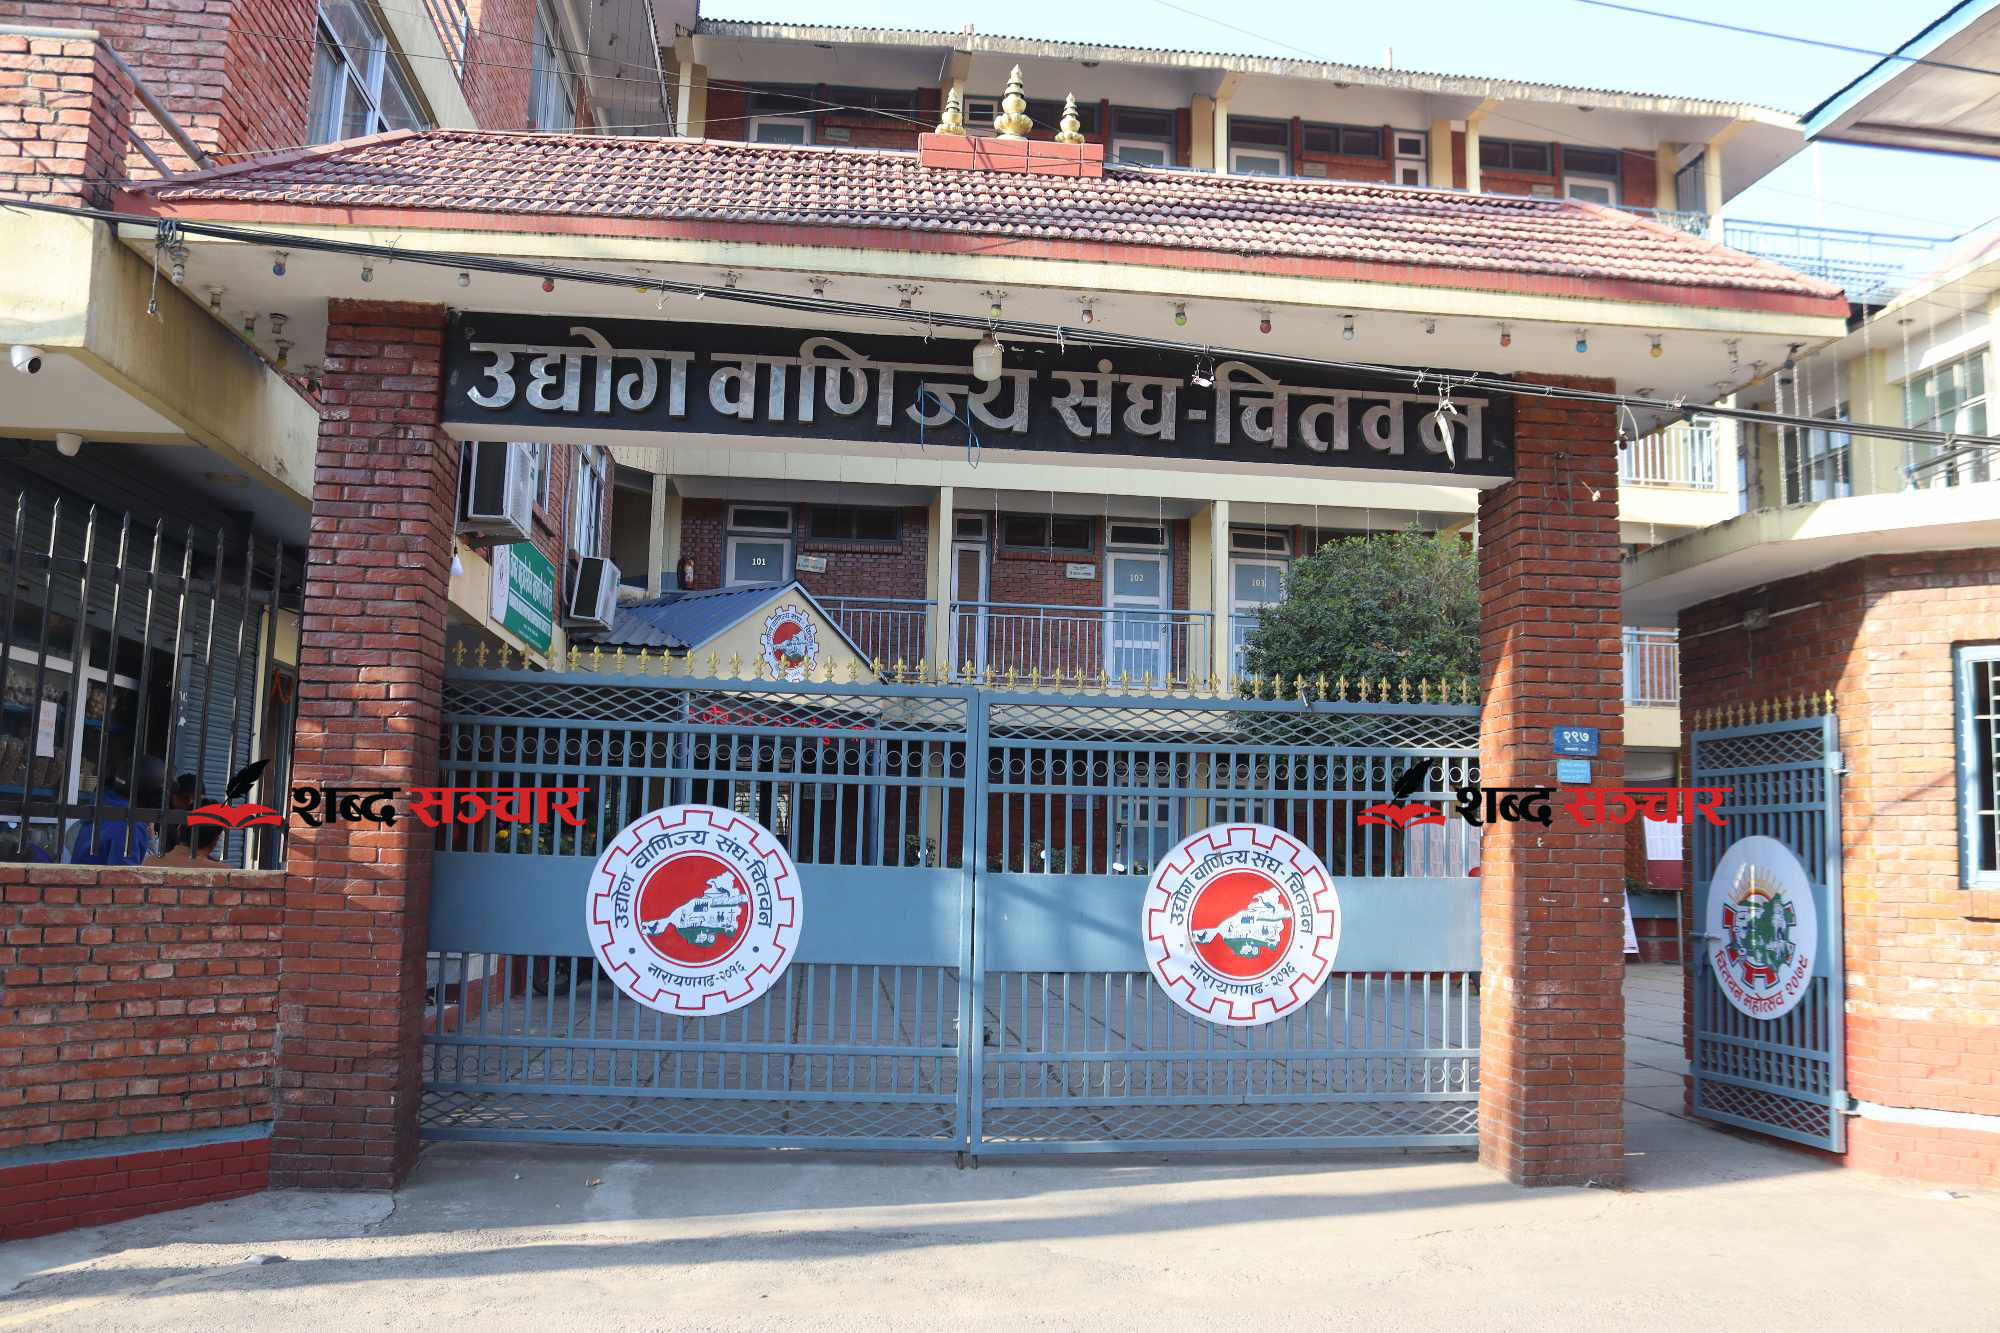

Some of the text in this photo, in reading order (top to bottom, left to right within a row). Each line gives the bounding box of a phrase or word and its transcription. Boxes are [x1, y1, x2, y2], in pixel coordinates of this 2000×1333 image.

[466, 326, 695, 417] उद्योग
[709, 336, 1037, 434] वाणिज्य
[752, 557, 766, 566] 101
[611, 864, 635, 928] उद्योग
[631, 830, 709, 869] वाणिज्य
[1170, 878, 1195, 926] उद्योग
[1191, 851, 1250, 881] वाणिज्य
[1715, 950, 1744, 1001] चितवन
